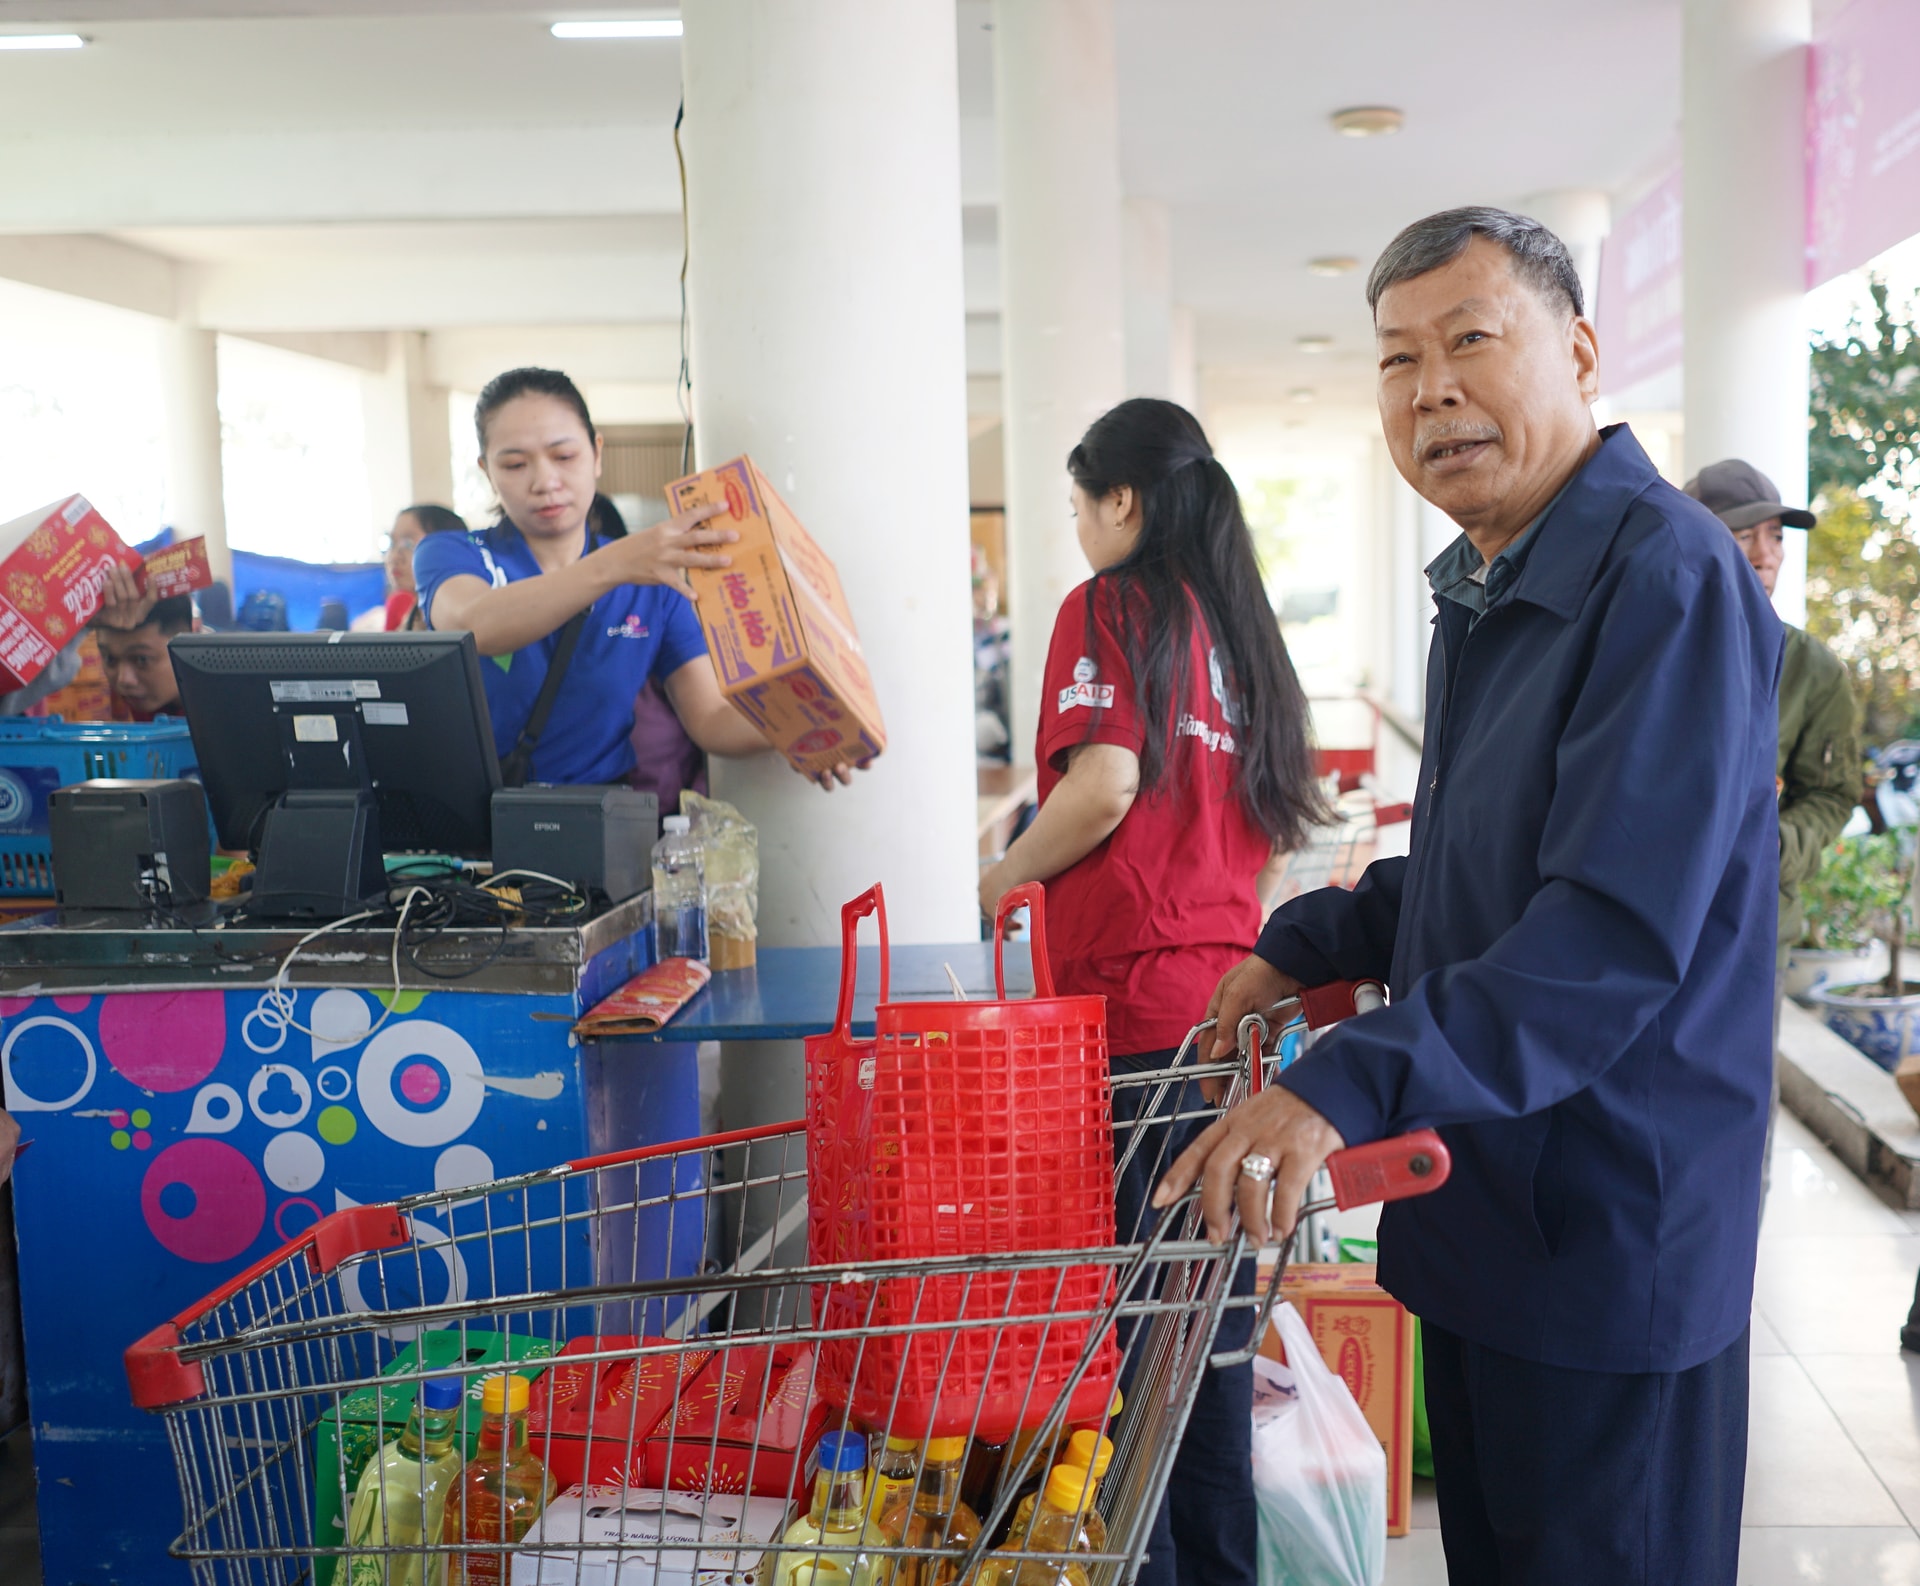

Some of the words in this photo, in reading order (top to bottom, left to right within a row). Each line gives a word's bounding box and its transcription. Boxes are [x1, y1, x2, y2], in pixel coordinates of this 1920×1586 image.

[722, 572, 756, 609] Hảo
[739, 611, 772, 648] Hảo
[1060, 684, 1113, 704] USAID
[534, 821, 561, 832] EPSON
[661, 1534, 695, 1543] ƯỢNG
